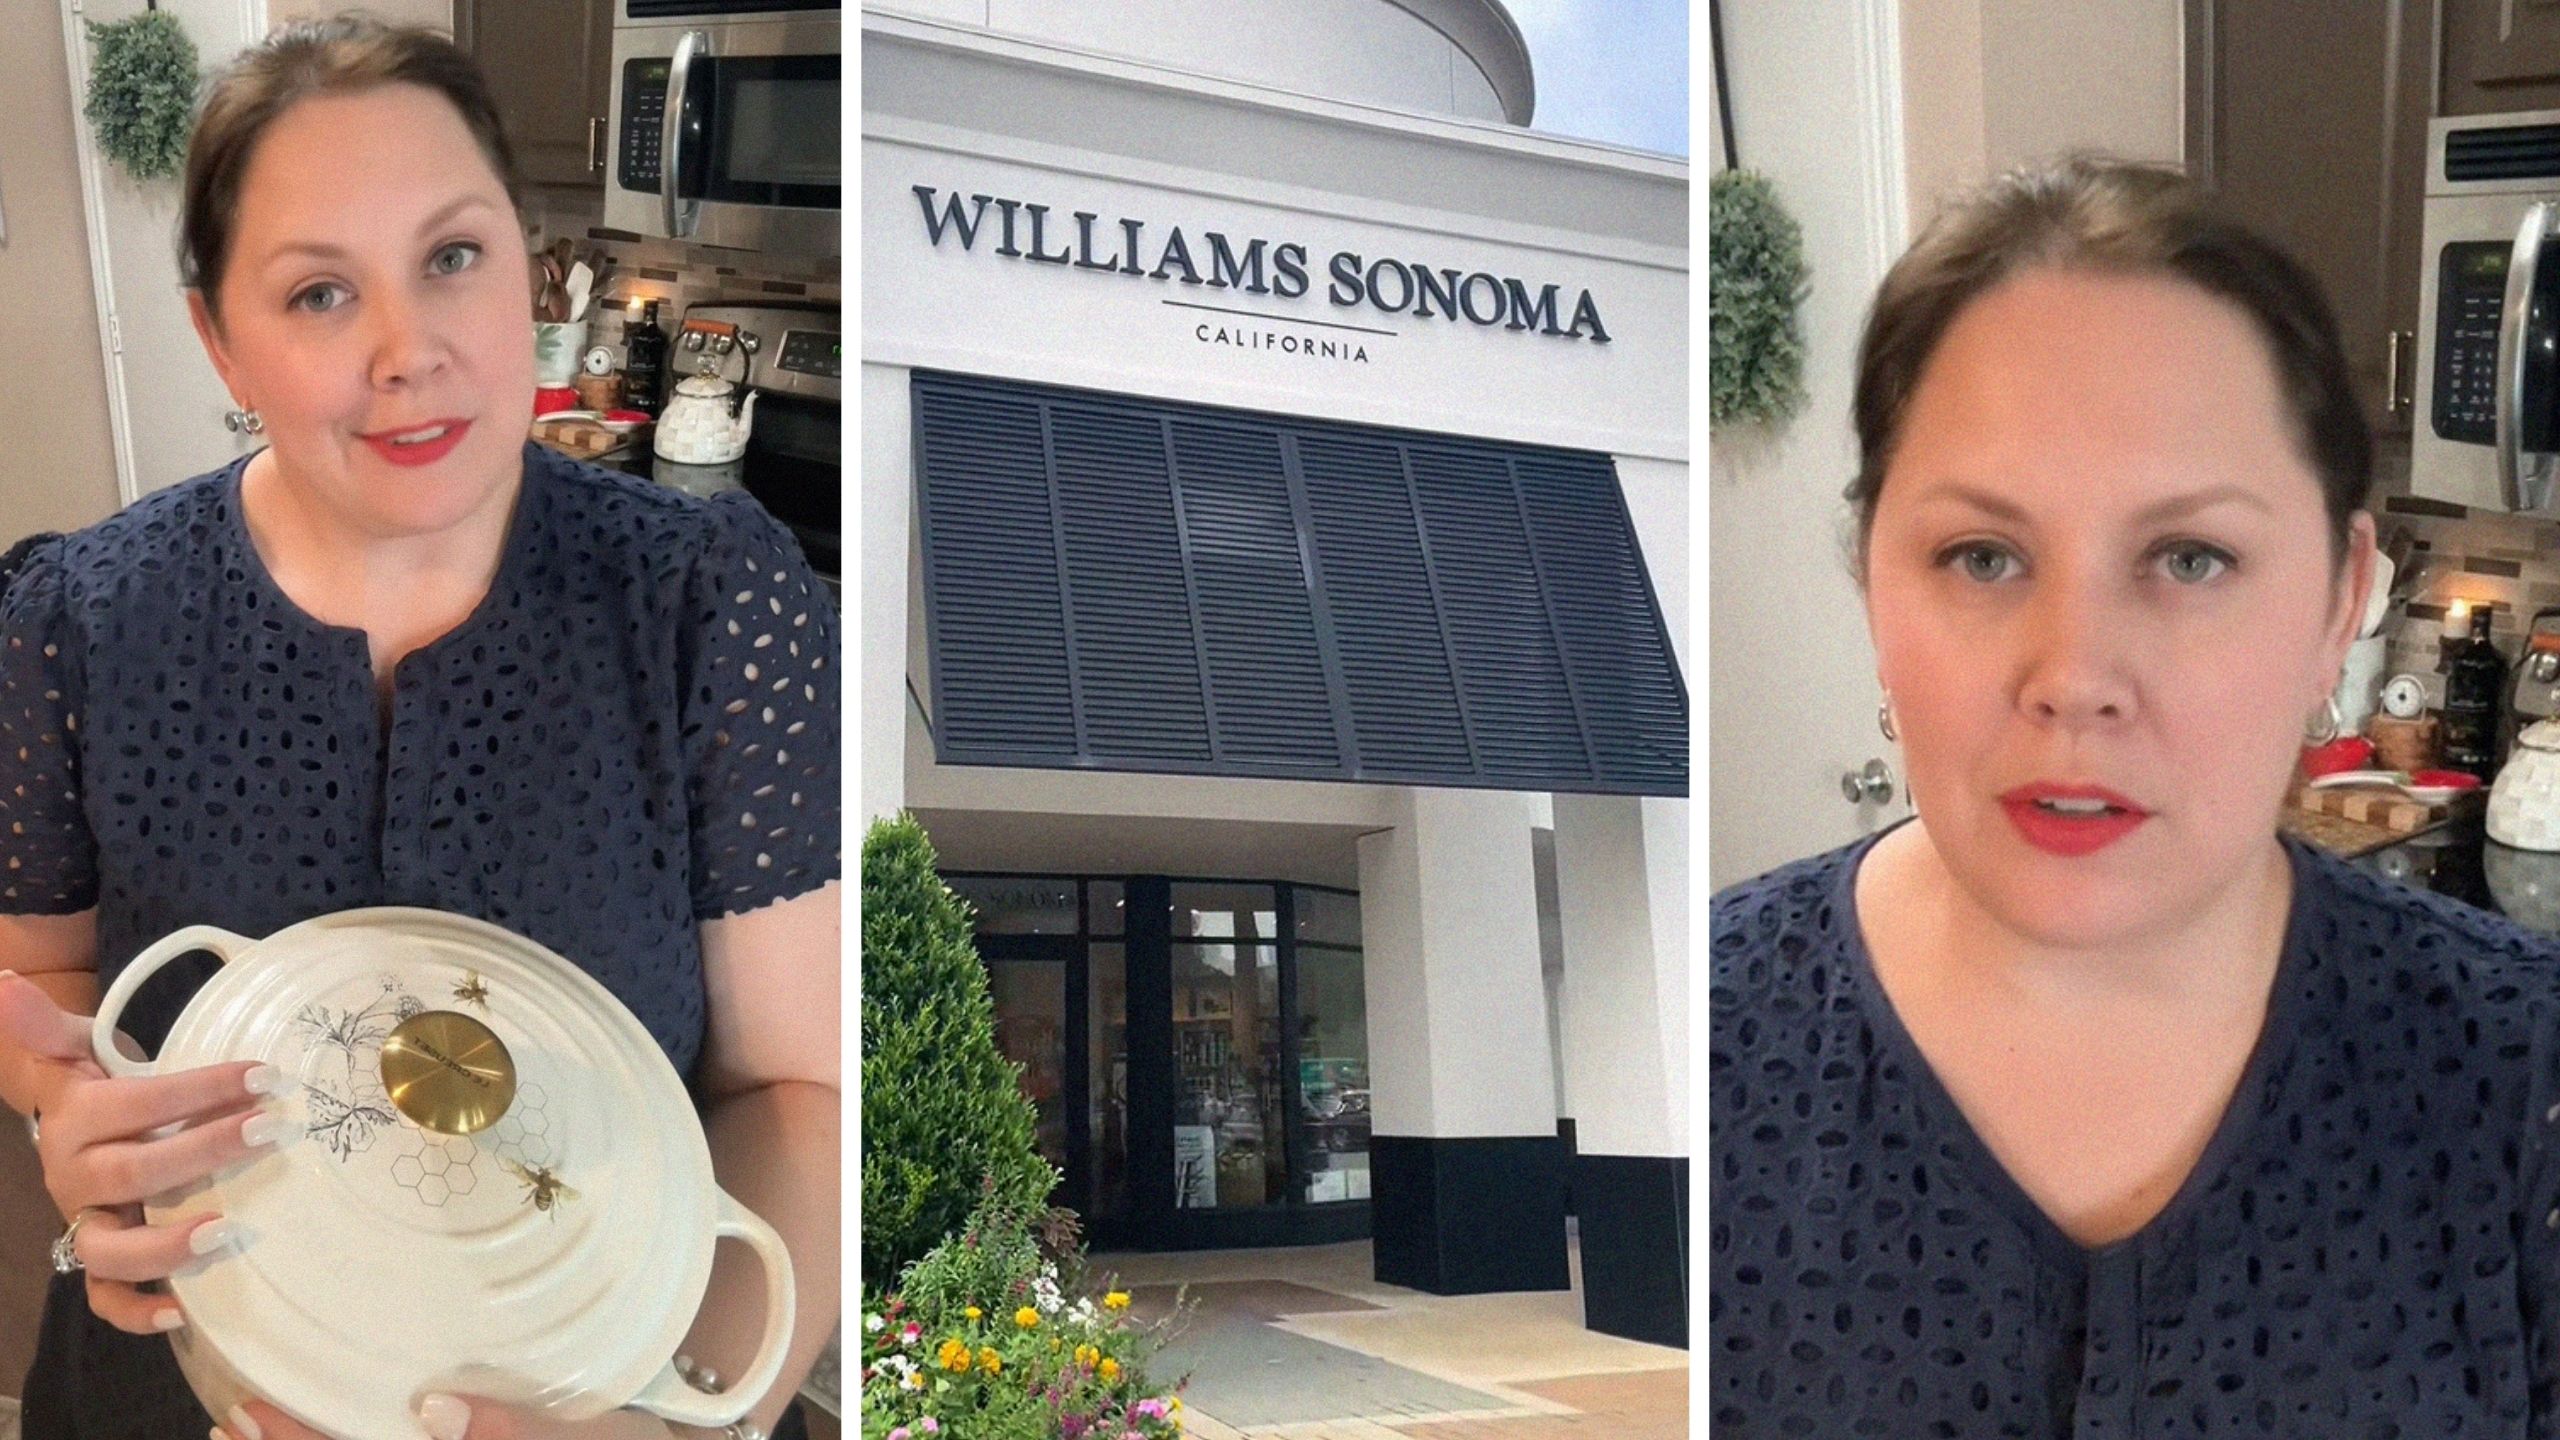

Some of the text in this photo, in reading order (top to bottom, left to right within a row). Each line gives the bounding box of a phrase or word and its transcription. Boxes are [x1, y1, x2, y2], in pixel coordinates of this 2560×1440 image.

[912, 185, 1612, 343] WILLIAMS SONOMA
[1196, 324, 1369, 363] CALIFORNIA
